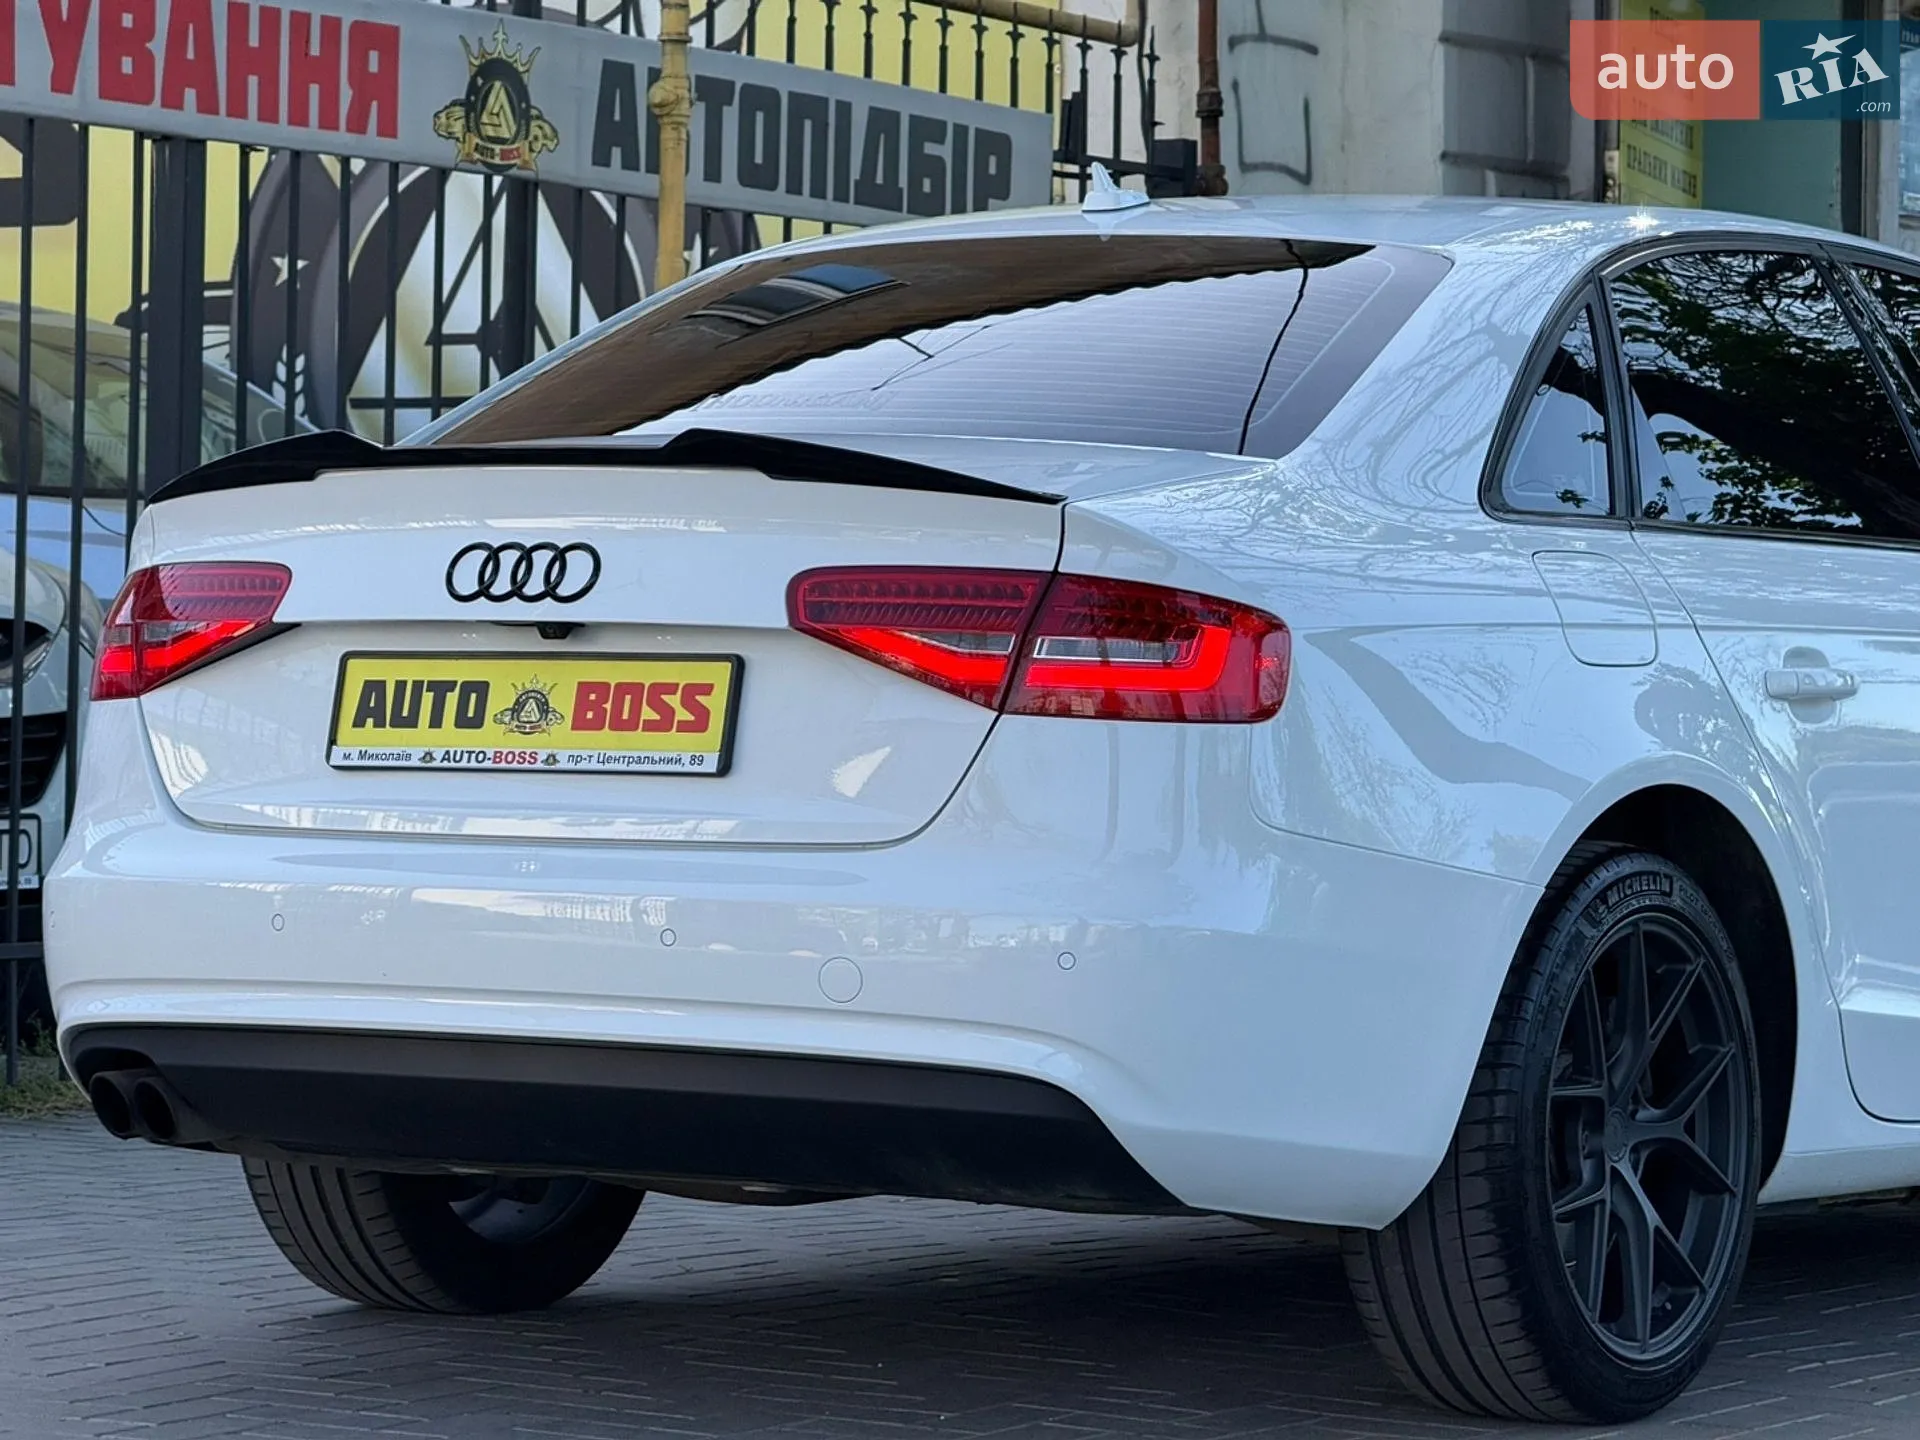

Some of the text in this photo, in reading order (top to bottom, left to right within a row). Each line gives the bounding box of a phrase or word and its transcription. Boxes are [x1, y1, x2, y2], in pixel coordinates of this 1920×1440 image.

[352, 679, 715, 733] AUTO BOSS
[357, 749, 412, 762] Миколаїв
[440, 750, 538, 765] AUTO-BOSS
[567, 753, 594, 766] пр-т
[597, 752, 685, 767] Центральний,
[689, 754, 704, 767] 89
[1606, 874, 1671, 907] MICHELIN
